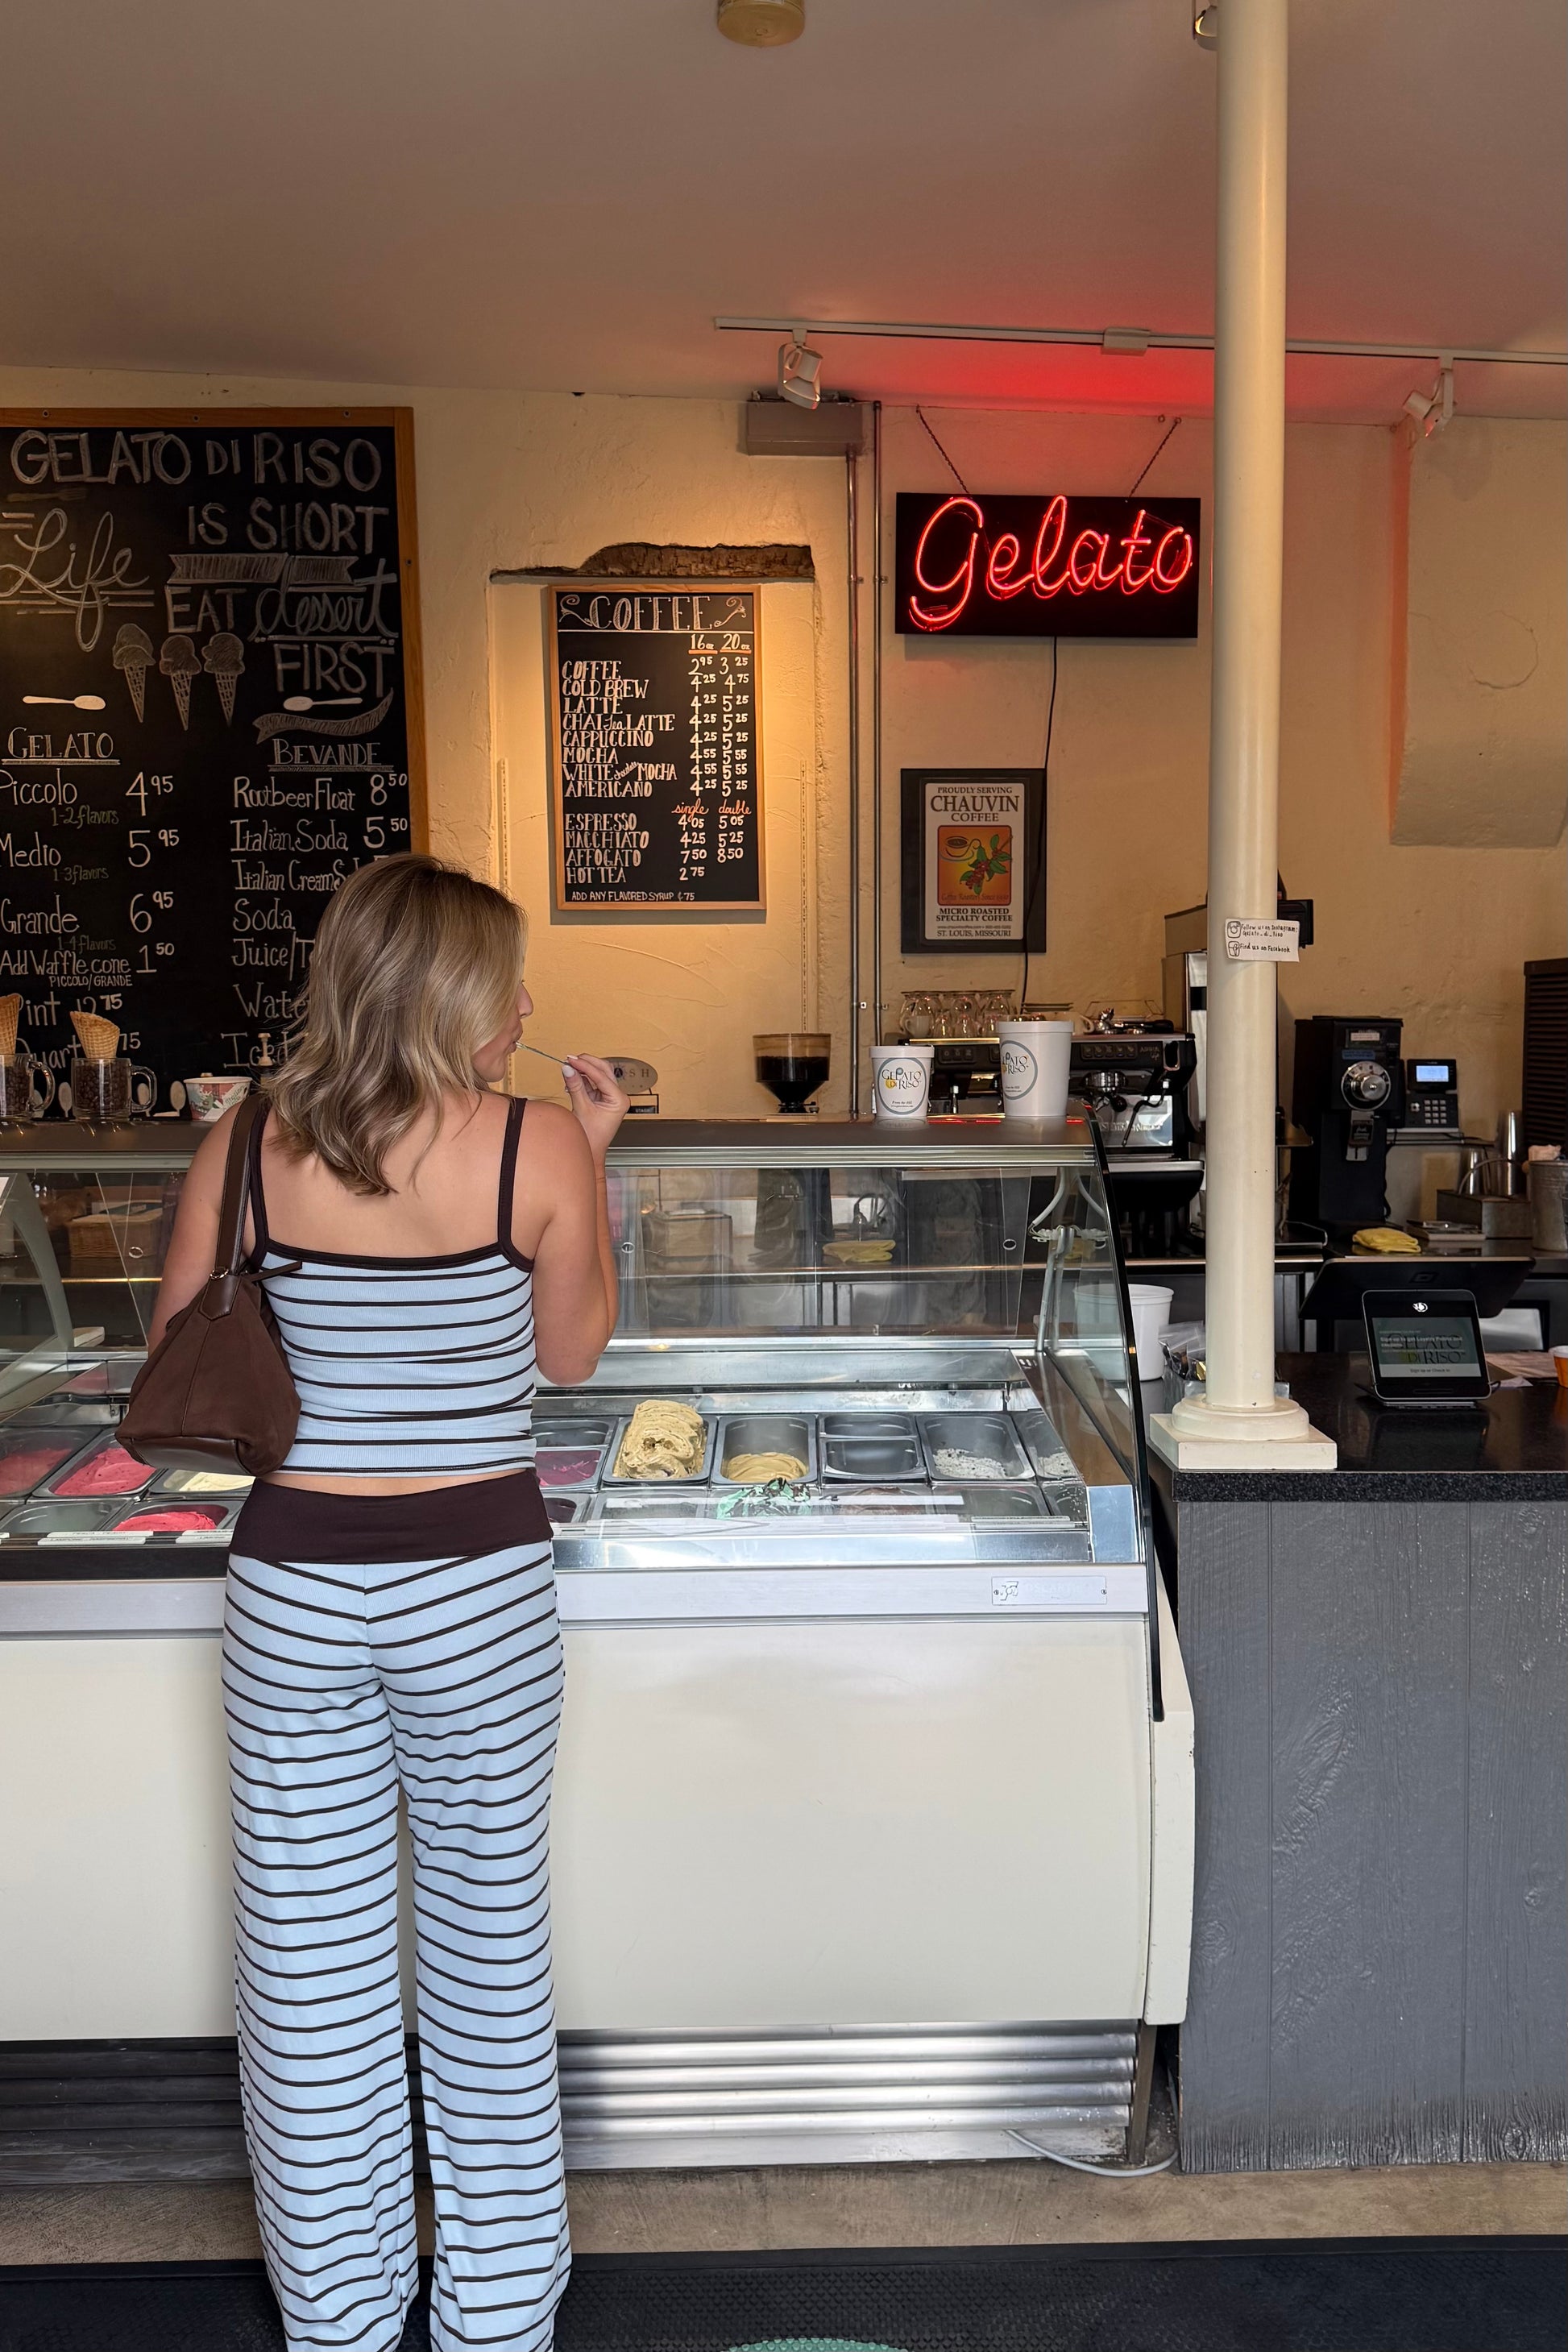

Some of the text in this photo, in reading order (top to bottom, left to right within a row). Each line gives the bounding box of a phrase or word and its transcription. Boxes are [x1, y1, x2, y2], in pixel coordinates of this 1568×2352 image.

[10, 429, 382, 492] GELATO DI RISO
[188, 497, 390, 554] IS SHORT
[910, 495, 1193, 623] Gelato
[0, 508, 151, 652] Life
[164, 558, 399, 641] EAT dessert
[589, 595, 713, 631] COFFEE
[273, 642, 396, 698] FIRST
[562, 660, 622, 681] COFFEE
[562, 679, 601, 696] COLD
[604, 679, 649, 699] BREW
[563, 697, 624, 714] LATTE
[562, 713, 603, 731] CHAI
[626, 714, 675, 731] LATTE
[7, 726, 114, 759] GELATO
[272, 738, 382, 765] BEVANDE
[562, 730, 654, 748] CAPPUCCINO
[562, 747, 619, 764] MOCHA
[562, 763, 614, 781] WHITE
[637, 762, 678, 781] MOCHA
[315, 778, 356, 811] Float
[564, 781, 653, 798] AMERICANO
[671, 798, 752, 822] single double
[930, 795, 1019, 812] CHAUVIN
[565, 813, 637, 832] ESPRESSO
[951, 812, 999, 822] COFFEE
[230, 819, 292, 852] Italian
[295, 819, 349, 852] Soda
[565, 831, 649, 849] MACCHIATO
[0, 832, 61, 868] Medio
[566, 848, 641, 868] AFFOGATO
[231, 859, 285, 891] Italian
[566, 867, 595, 884] HOT
[597, 866, 627, 883] TEA
[571, 891, 588, 902] ADD
[589, 891, 607, 901] ANY
[608, 891, 648, 901] FLAVORED
[648, 892, 674, 901] SYRUP
[0, 894, 81, 934] Grande
[232, 898, 296, 931] Soda
[0, 949, 29, 976] Add
[30, 949, 88, 976] Waffle
[91, 958, 131, 975] cone
[19, 991, 61, 1026] int
[232, 981, 309, 1019] Wate
[881, 1068, 922, 1081] GELATO
[1424, 1351, 1462, 1364] RISO
